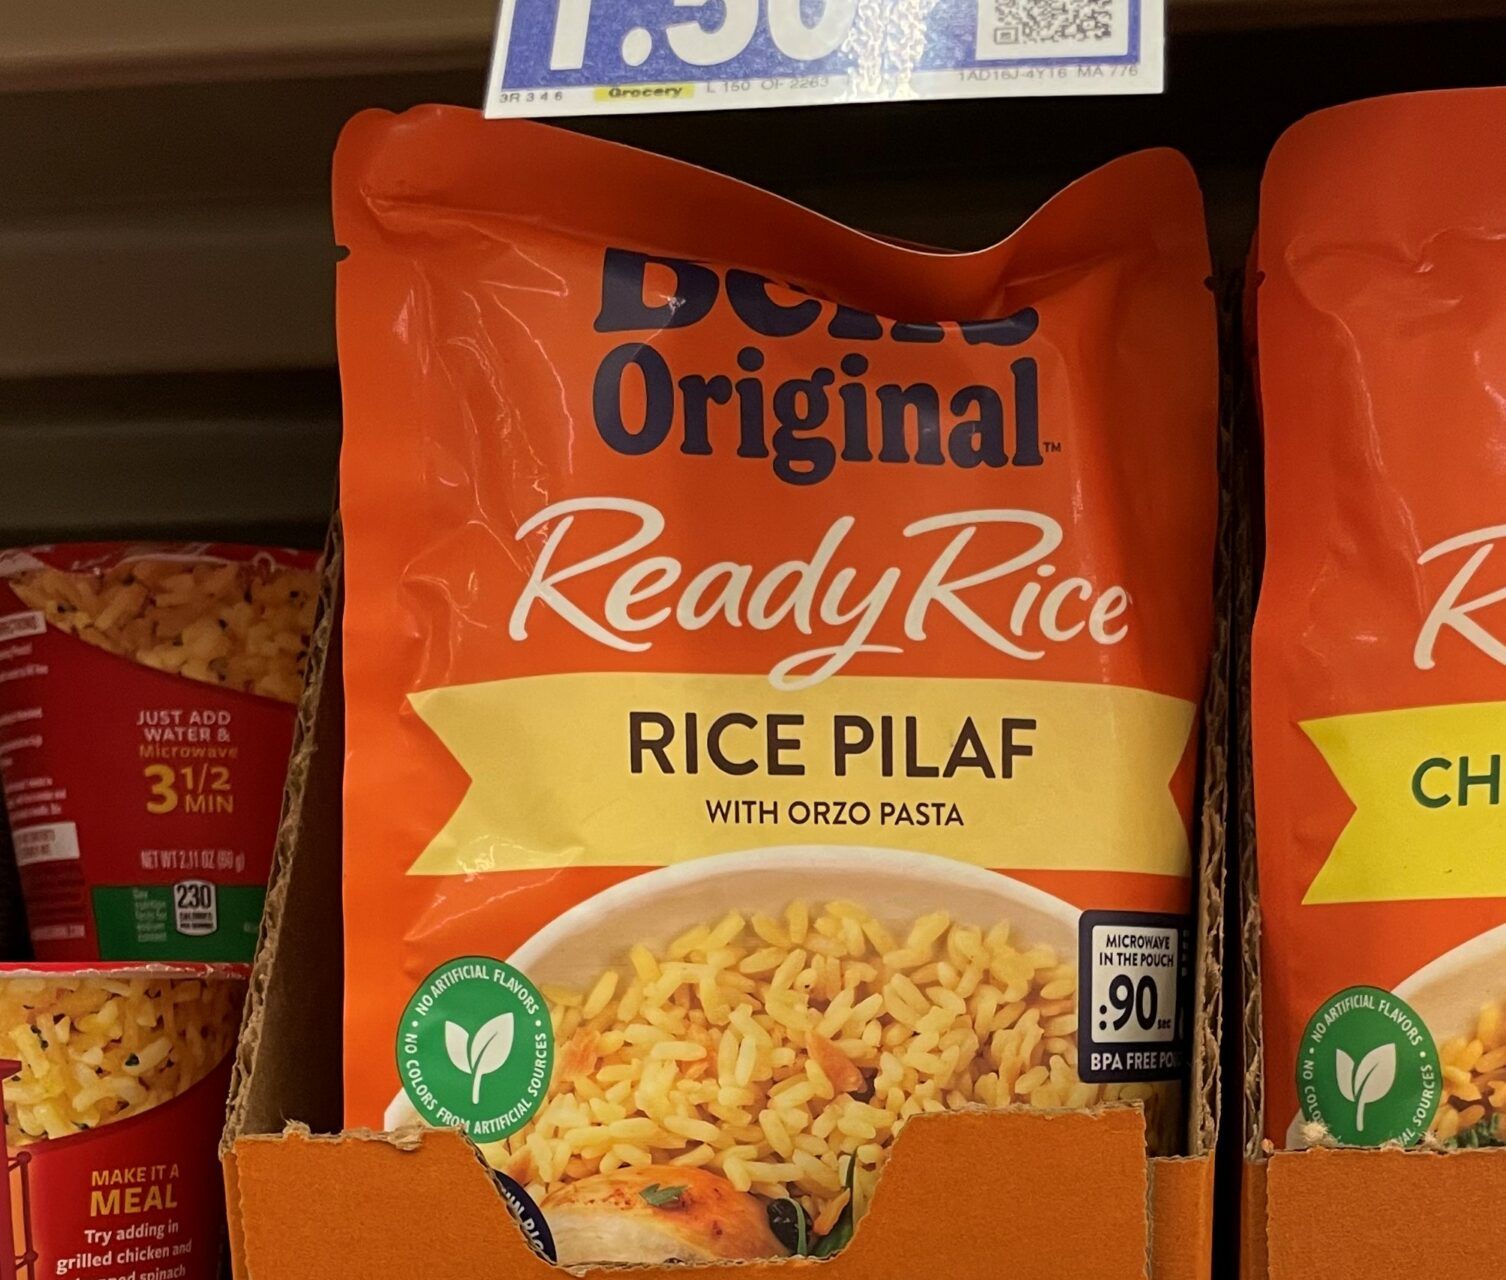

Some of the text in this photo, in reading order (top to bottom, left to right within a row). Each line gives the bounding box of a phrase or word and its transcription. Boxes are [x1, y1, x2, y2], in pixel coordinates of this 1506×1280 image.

[608, 85, 684, 99] Grocery
[592, 342, 1044, 485] Original
[508, 496, 1130, 691] Ready Rice
[136, 710, 231, 726] JUST ADD
[144, 727, 210, 742] WATER
[629, 711, 1037, 779] RICE PILAF
[140, 745, 238, 759] Microwave
[144, 763, 231, 814] 3 1/2
[184, 795, 234, 813] MIN
[706, 799, 964, 827] WITH ORZO PASTA
[177, 884, 212, 909] 230
[1106, 934, 1170, 950] MICROWAVE
[1100, 953, 1174, 967] IN THE POUCH
[415, 965, 540, 1016] NO ARTIFICIAL FLAVORS
[1157, 1018, 1171, 1030] sec
[1311, 994, 1423, 1046] NO ARTIFICIAL FLAVORS
[405, 1033, 418, 1054] NO
[527, 1033, 547, 1097] SOURCES
[1091, 1052, 1157, 1070] BPA FREE
[406, 1059, 438, 1110] COLORS
[1303, 1060, 1435, 1127] NO SOURCES
[474, 1098, 532, 1135] ARTIFICIAL
[92, 1163, 179, 1187] MAKE IT A
[90, 1184, 178, 1217] MEAL
[84, 1219, 179, 1246] Try adding in
[56, 1238, 192, 1275] grilled chicken and
